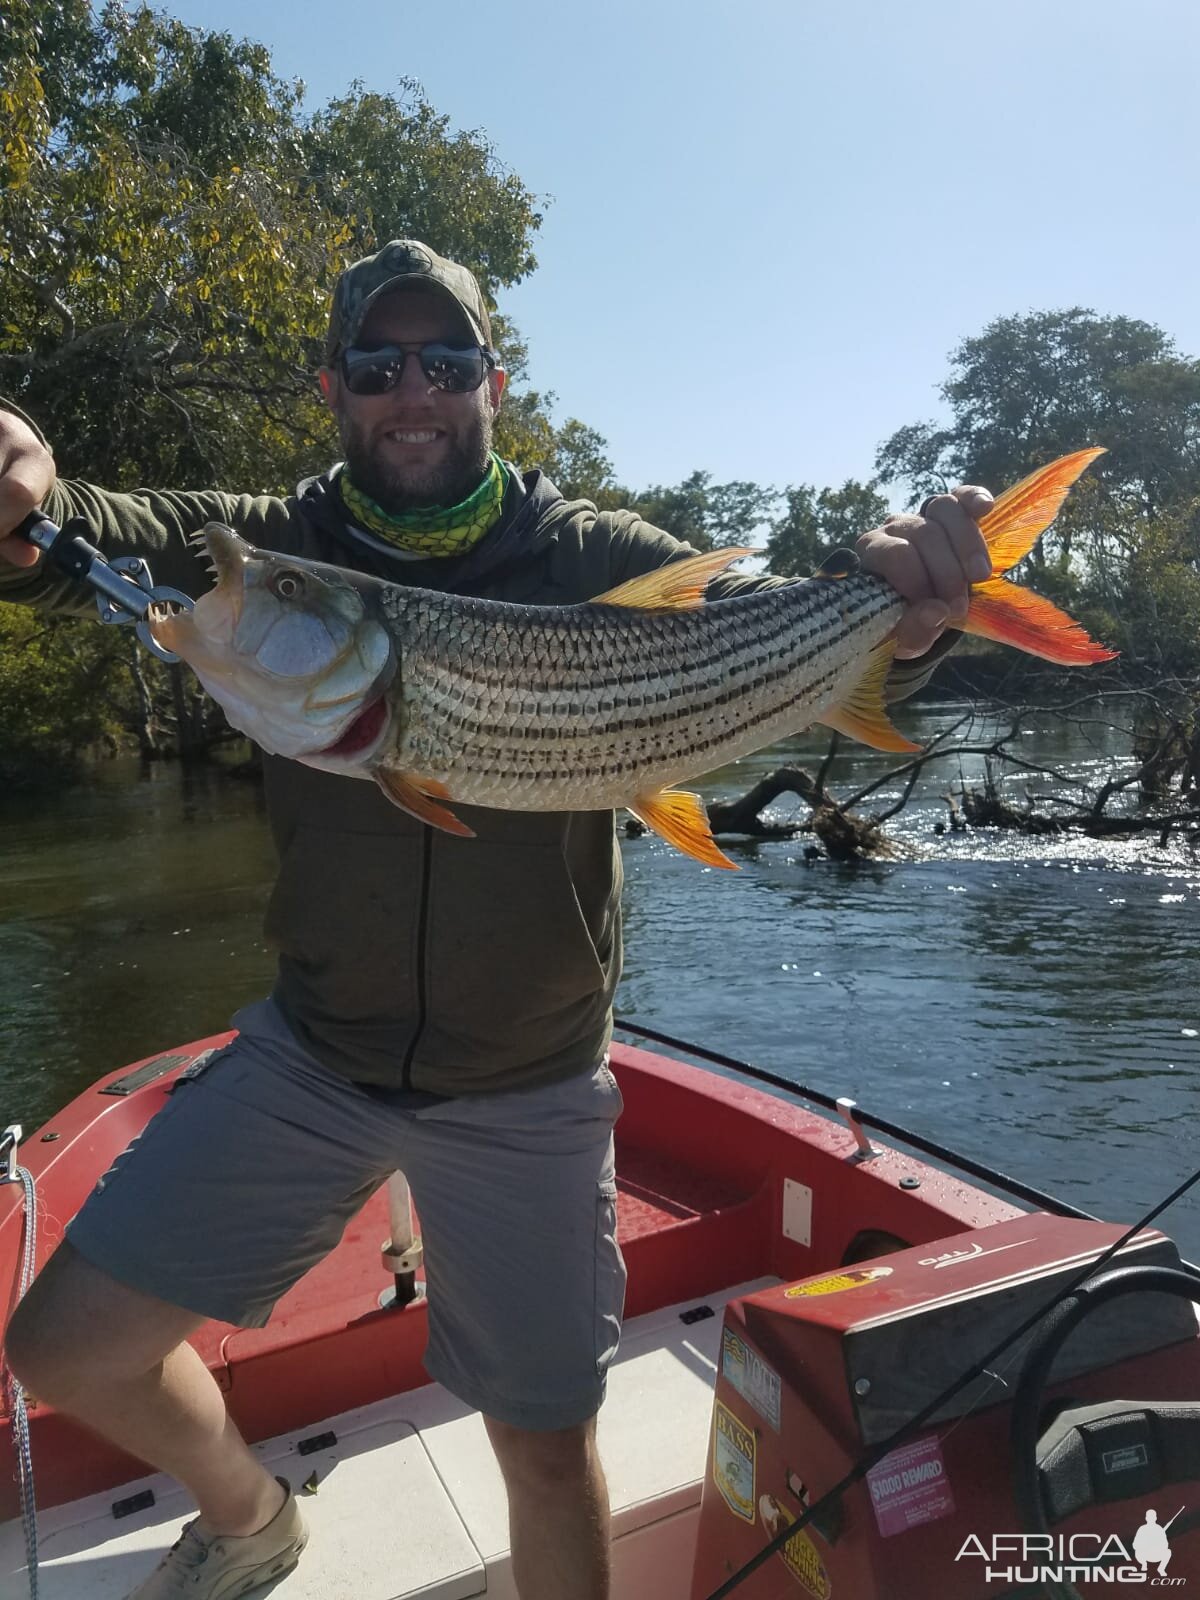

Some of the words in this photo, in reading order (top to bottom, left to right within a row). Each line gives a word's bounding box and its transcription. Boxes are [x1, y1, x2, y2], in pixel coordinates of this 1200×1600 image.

[718, 1412, 753, 1460] BASS
[872, 1475, 902, 1500] $1000
[902, 1460, 942, 1488] REWARD
